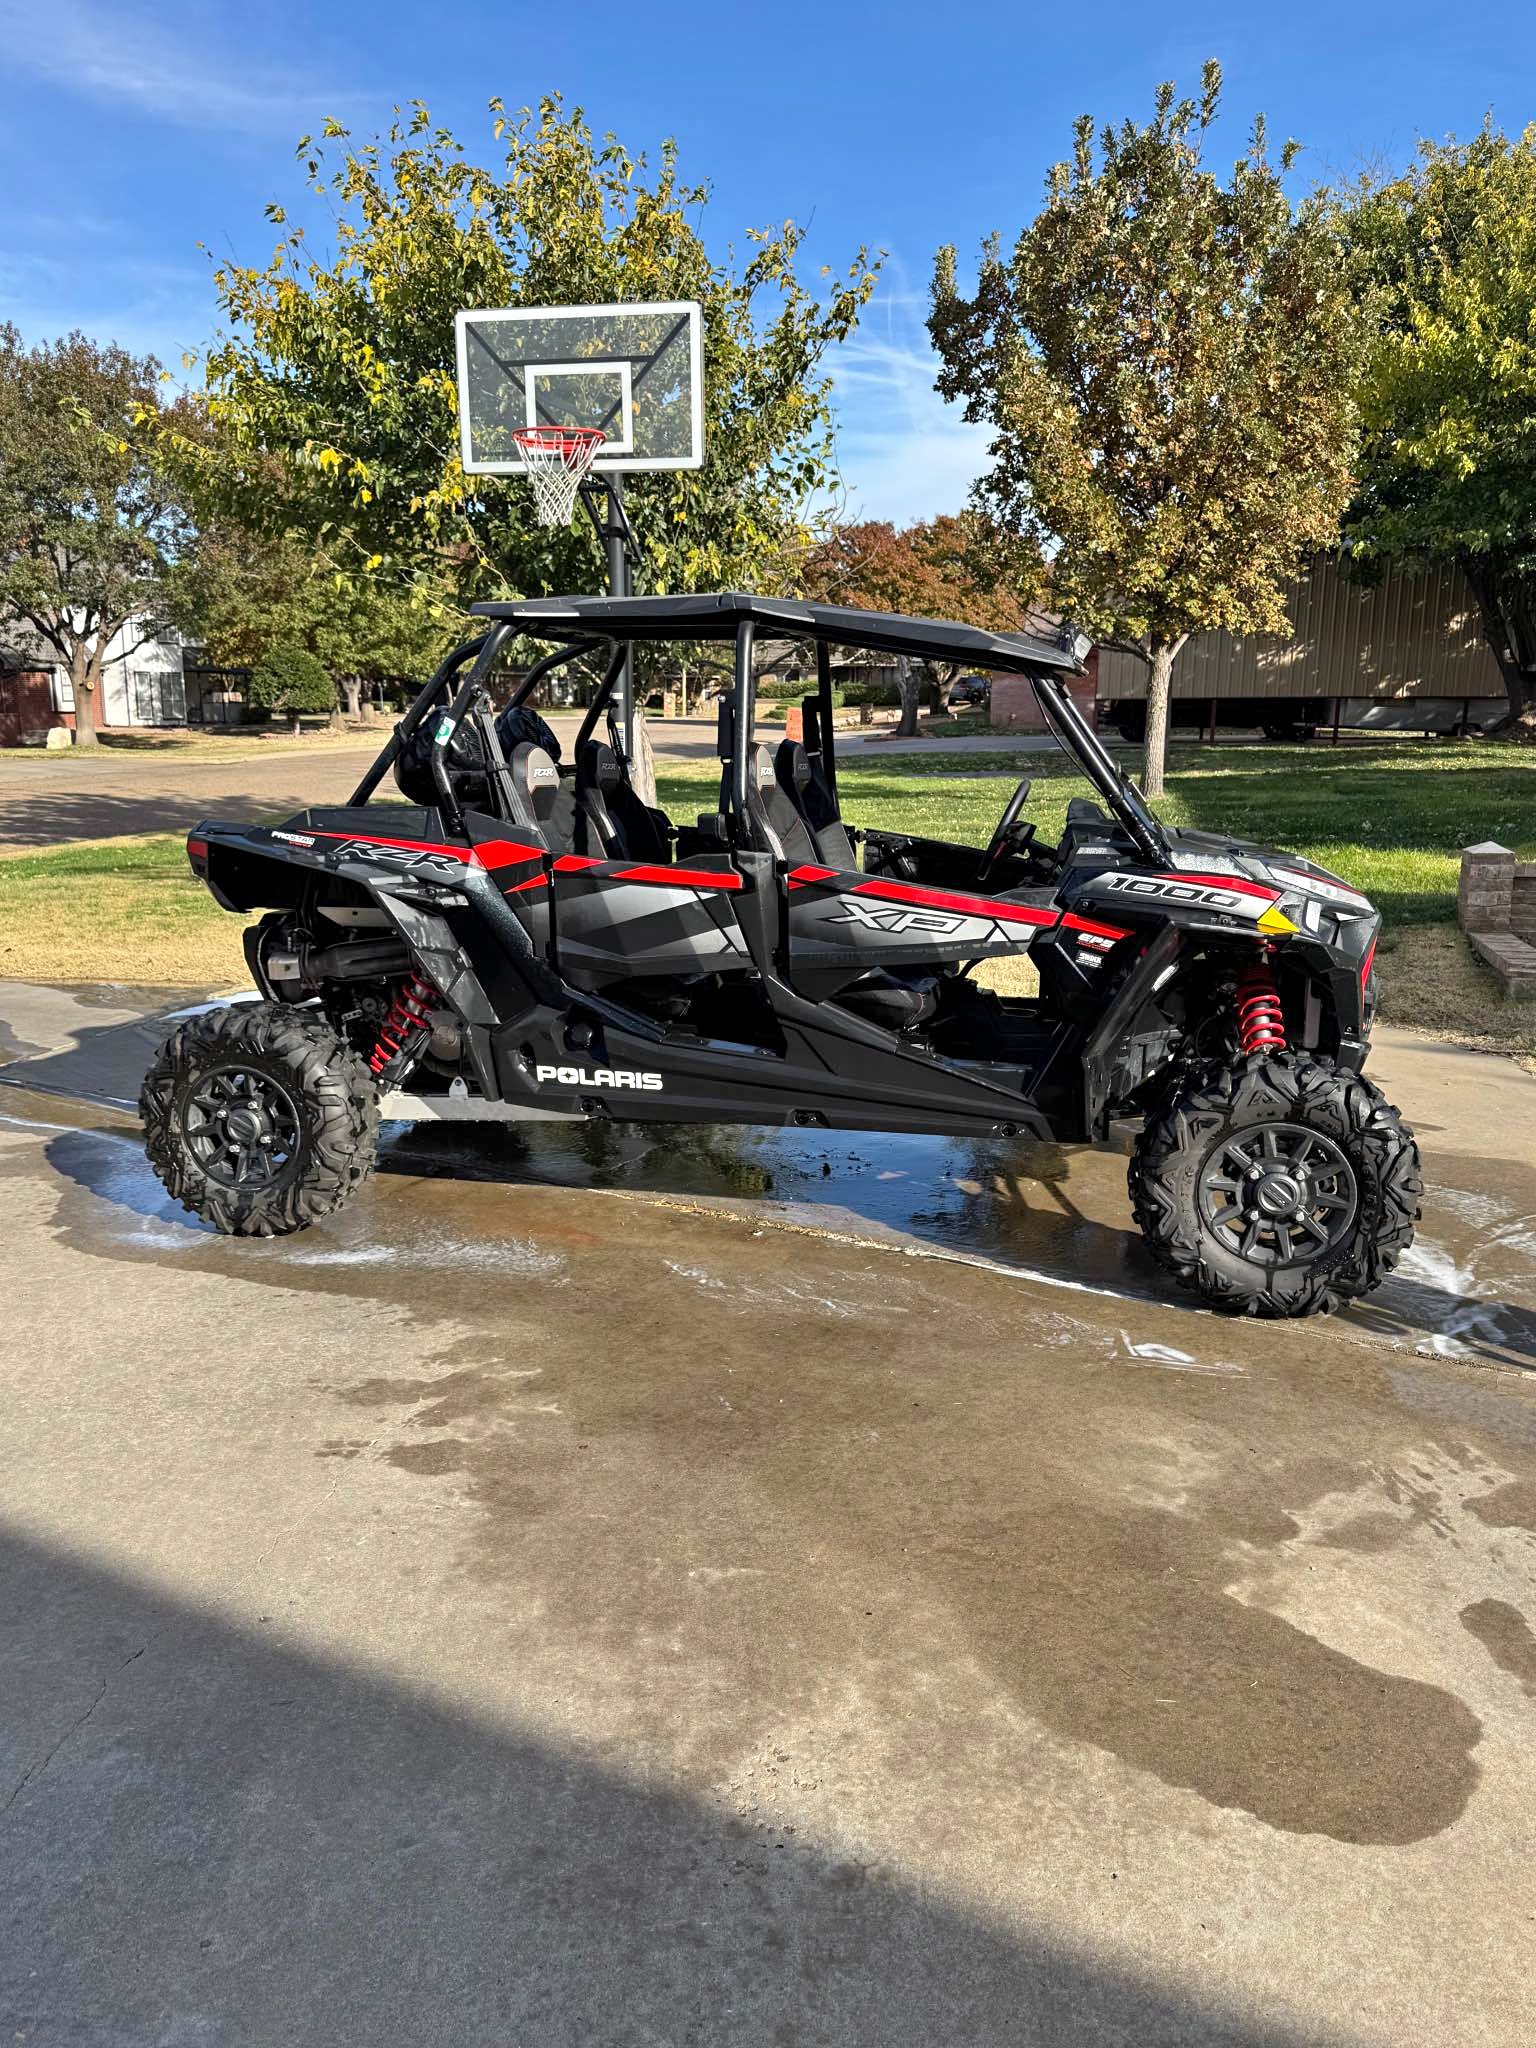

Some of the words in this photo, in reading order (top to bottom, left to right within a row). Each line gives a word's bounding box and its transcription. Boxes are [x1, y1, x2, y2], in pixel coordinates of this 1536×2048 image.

[533, 767, 554, 778] RZR
[333, 839, 462, 875] RZR
[1107, 876, 1243, 908] 1000
[815, 900, 969, 934] XP
[1077, 932, 1117, 949] EPS
[536, 1065, 664, 1091] POLARIS
